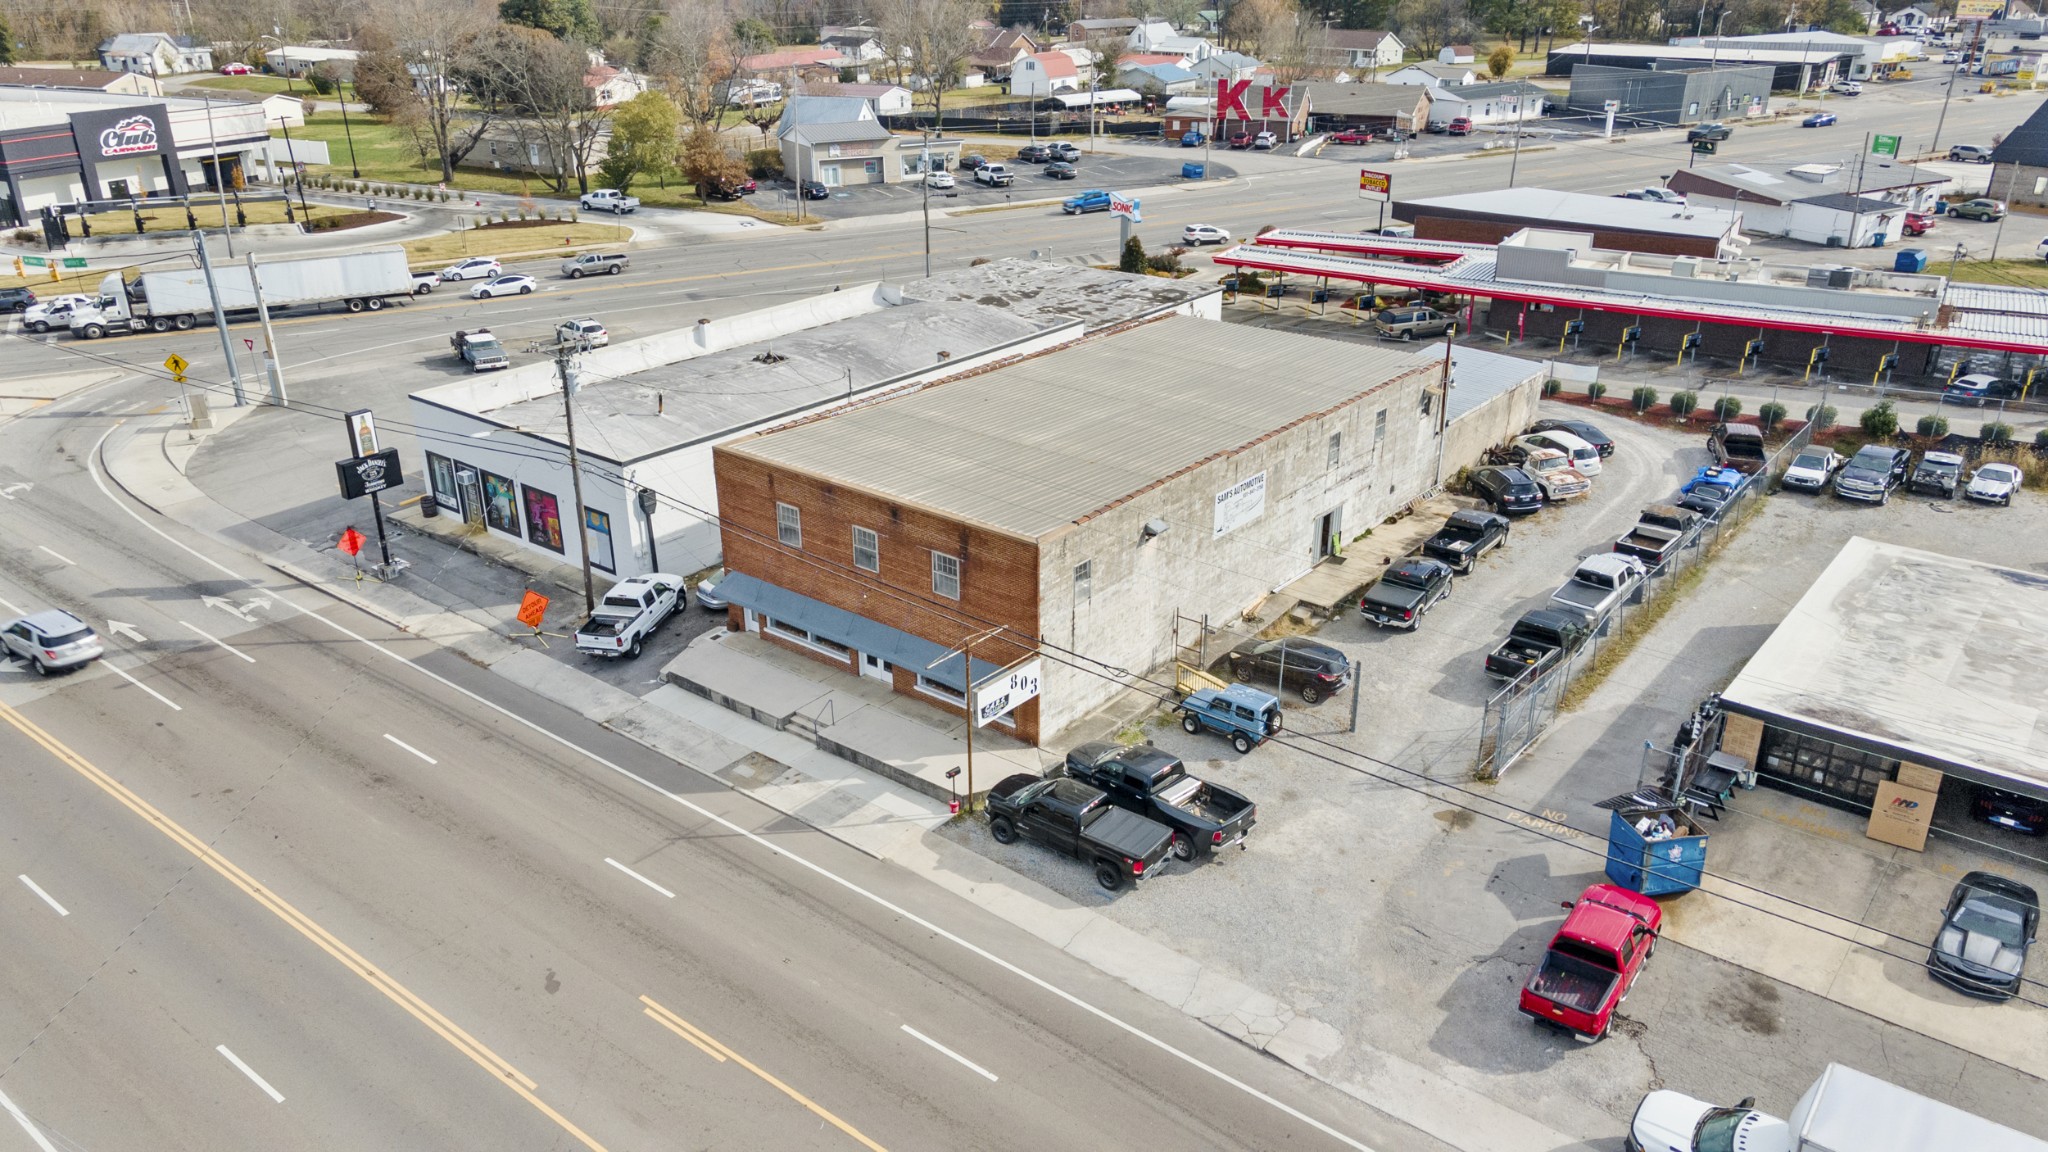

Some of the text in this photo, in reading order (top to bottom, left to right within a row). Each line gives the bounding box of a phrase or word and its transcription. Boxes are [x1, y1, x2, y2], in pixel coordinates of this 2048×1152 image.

[1217, 78, 1291, 121] K K
[101, 128, 156, 148] Club
[1363, 178, 1386, 187] TOBACCO
[1111, 201, 1133, 214] SONIC
[1217, 489, 1234, 505] SAM'S
[1234, 473, 1265, 496] AUTOMOTIVE
[522, 597, 542, 614] DETOUR
[525, 605, 543, 619] AHEAD
[1010, 674, 1038, 695] 803
[1541, 808, 1567, 823] NO
[1506, 811, 1585, 840] PARKING
